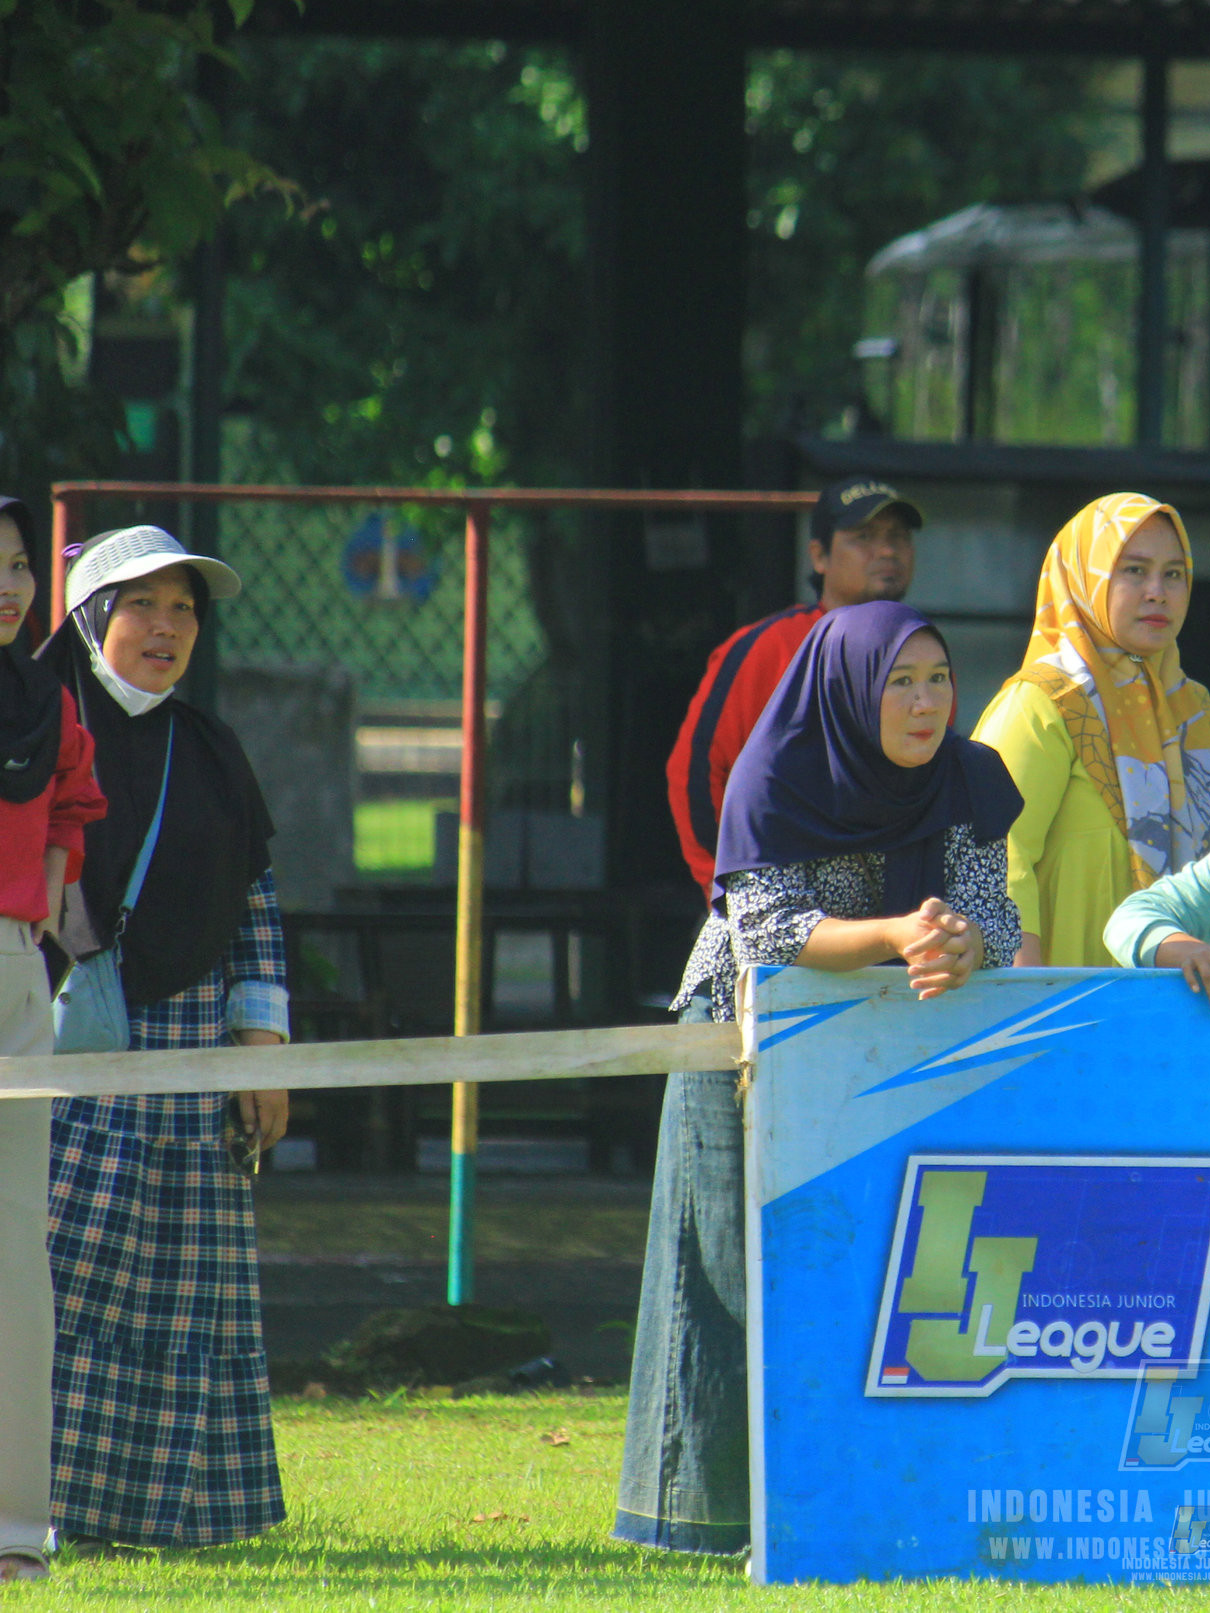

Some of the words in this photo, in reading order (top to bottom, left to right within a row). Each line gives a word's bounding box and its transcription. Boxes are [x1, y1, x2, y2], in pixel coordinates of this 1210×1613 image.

[1022, 1293, 1111, 1308] INDONESIA
[1116, 1294, 1176, 1309] JUNIOR
[972, 1303, 1175, 1373] League
